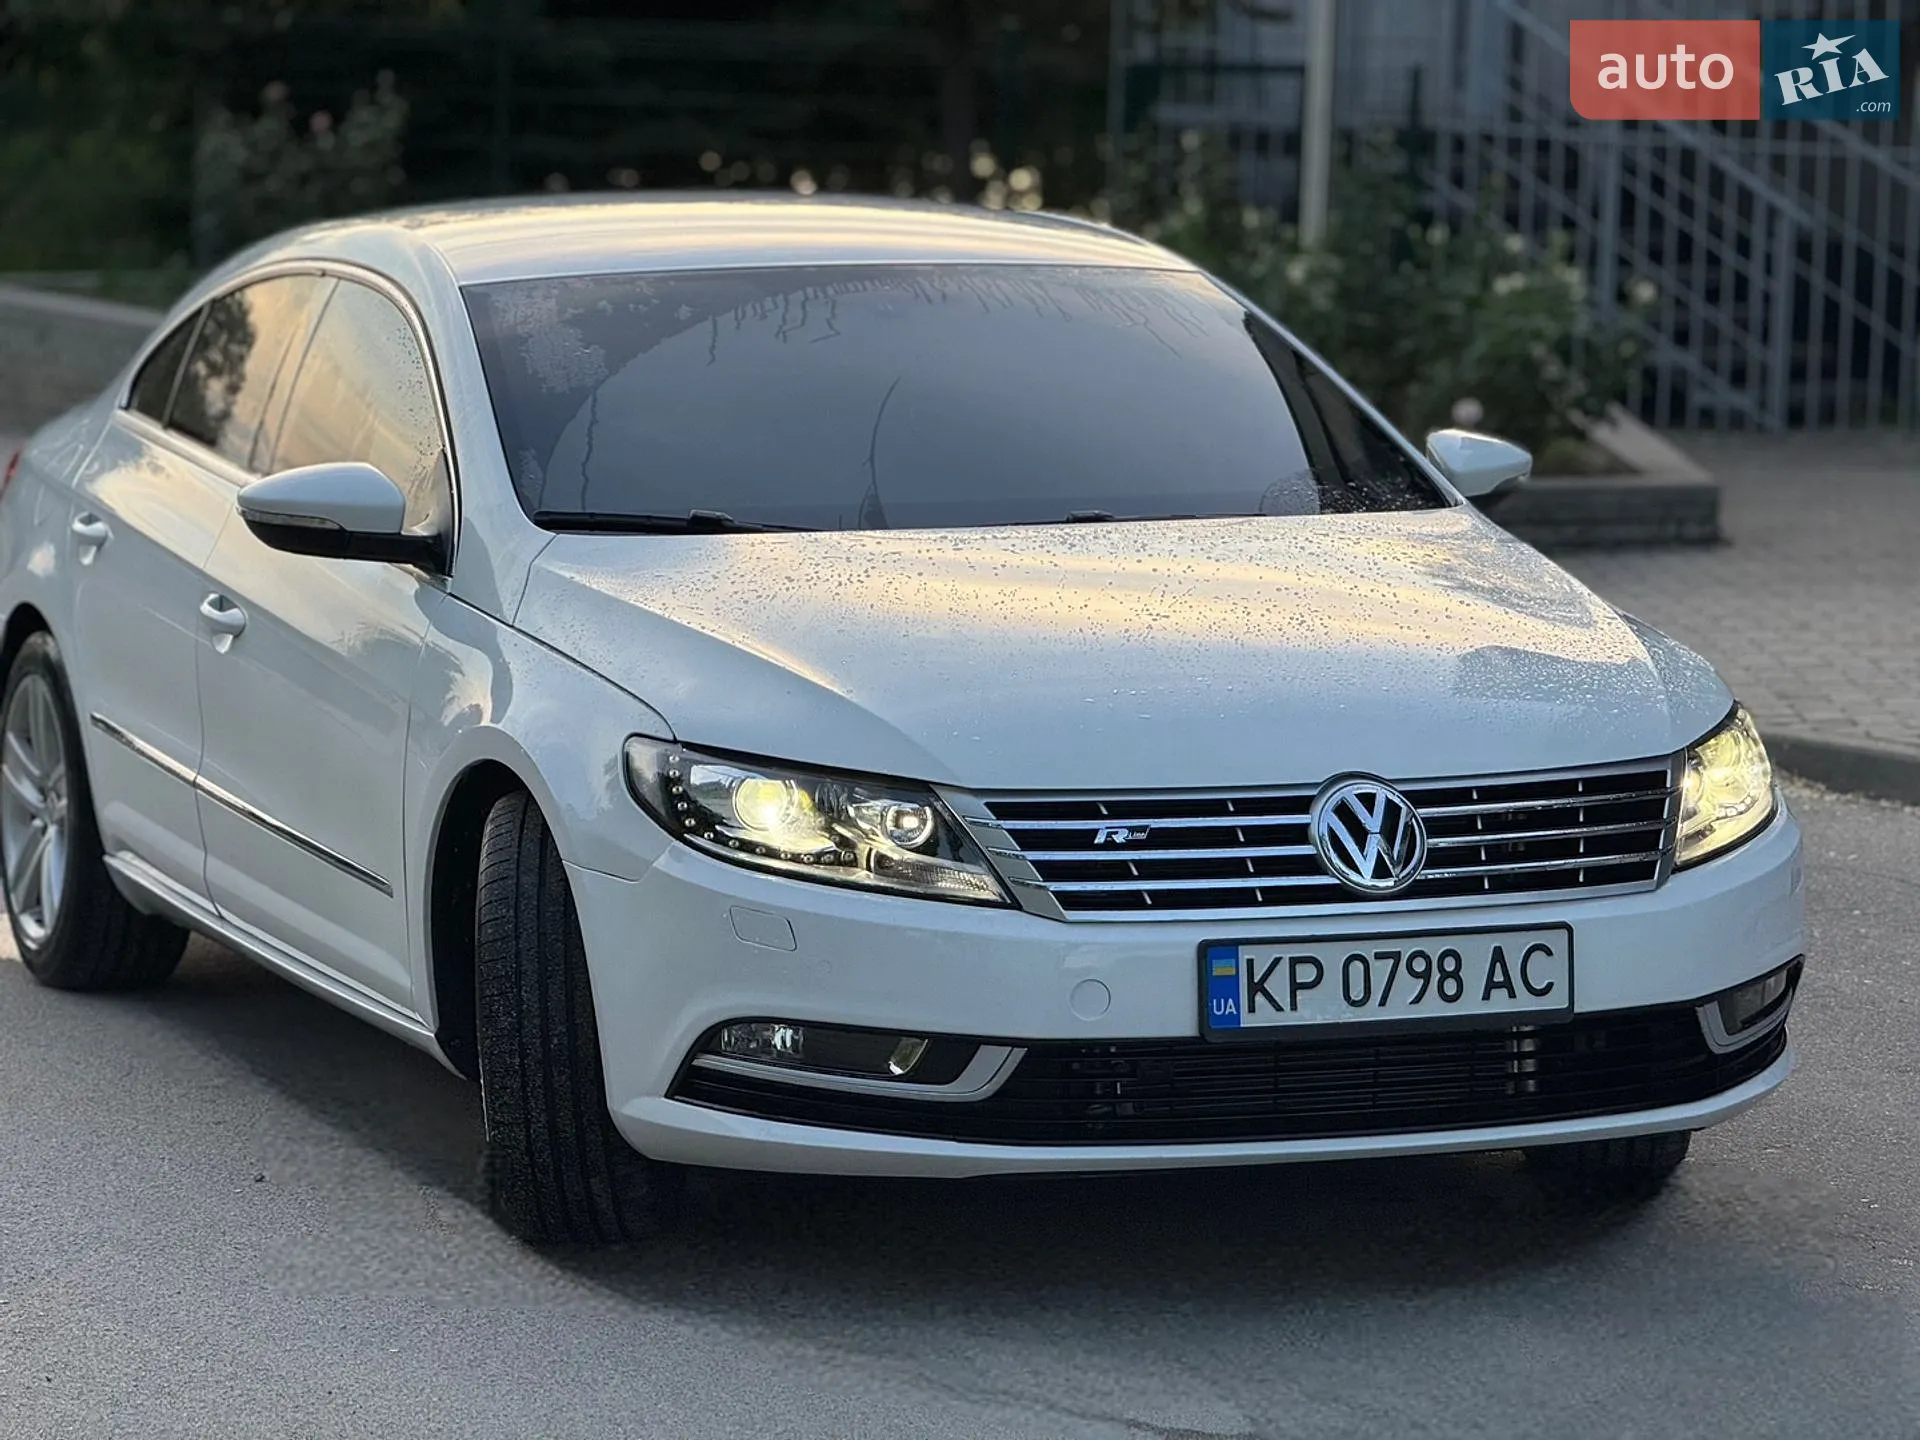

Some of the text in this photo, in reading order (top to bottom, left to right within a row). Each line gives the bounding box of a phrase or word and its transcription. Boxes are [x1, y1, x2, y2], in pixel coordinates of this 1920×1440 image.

[1245, 943, 1555, 1014] KP 0798 AC
[1213, 999, 1238, 1016] UA
